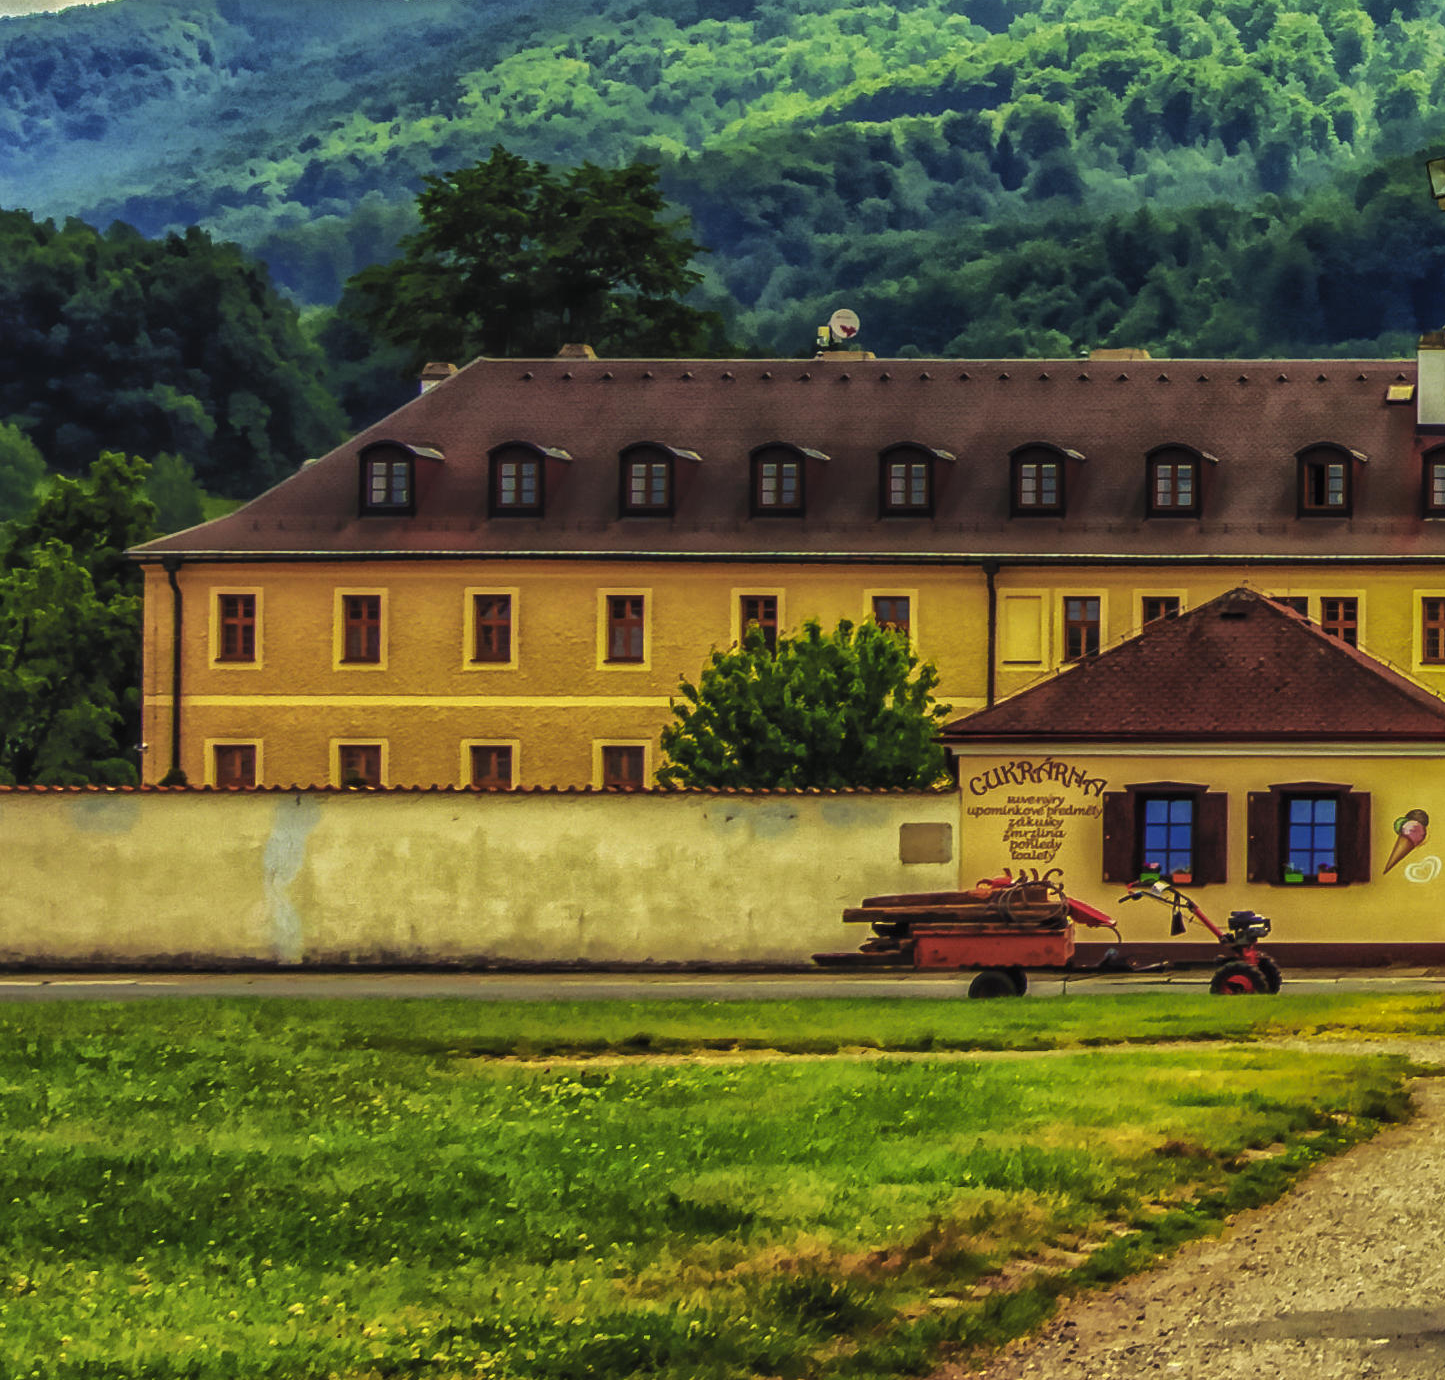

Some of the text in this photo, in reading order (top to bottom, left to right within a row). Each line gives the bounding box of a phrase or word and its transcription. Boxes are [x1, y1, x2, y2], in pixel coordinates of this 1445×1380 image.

[969, 757, 1108, 797] CUKRÁRNA
[967, 804, 1103, 819] upomínkové předměty
[1009, 838, 1062, 852] pohledy
[1012, 850, 1056, 863] toalety
